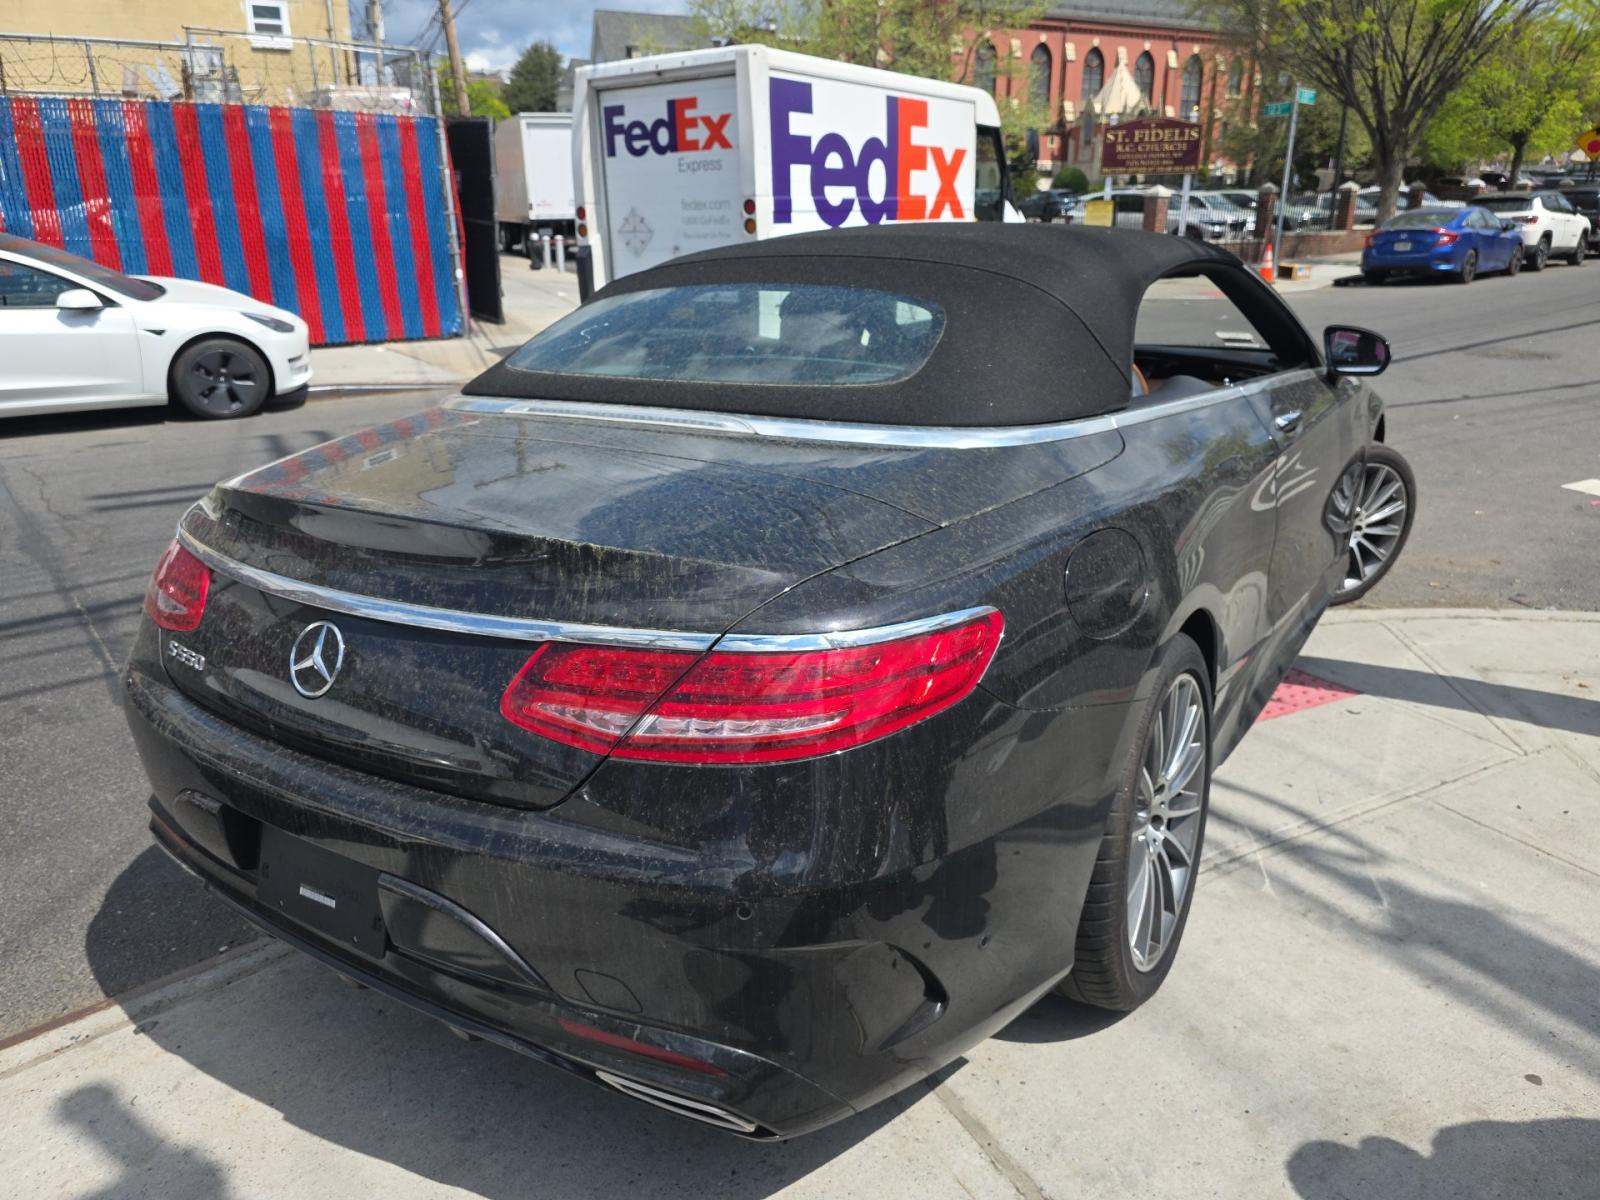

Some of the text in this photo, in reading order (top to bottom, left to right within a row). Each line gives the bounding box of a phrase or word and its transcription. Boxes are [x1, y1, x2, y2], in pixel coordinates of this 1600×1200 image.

[604, 96, 733, 157] FedEx
[1105, 127, 1199, 143] ST. FIDELIS
[769, 77, 967, 228] FedEx
[1138, 142, 1187, 152] CHURCH
[678, 158, 722, 174] Express
